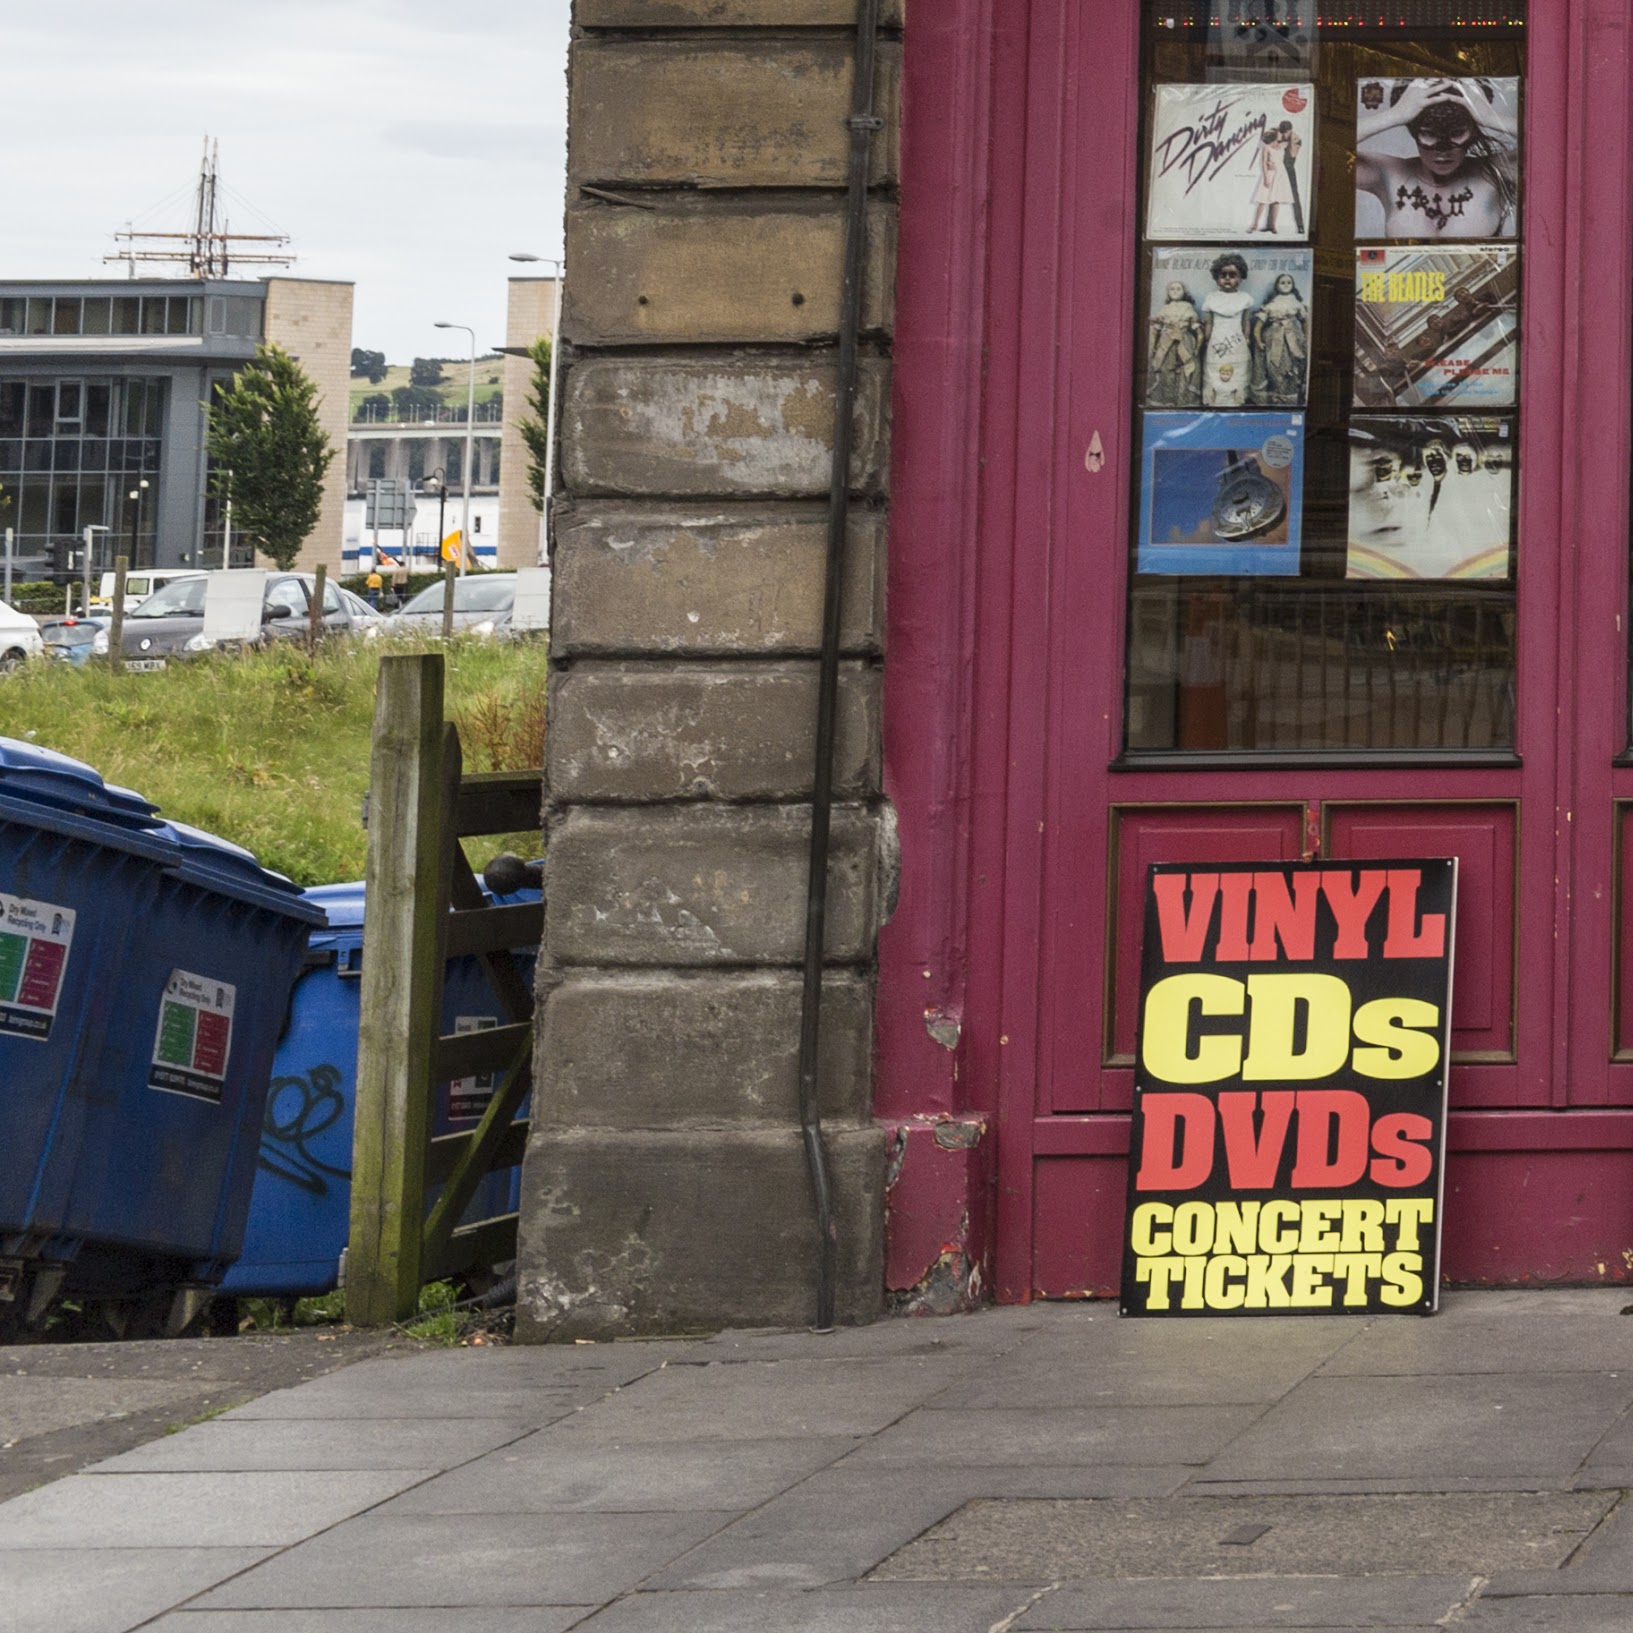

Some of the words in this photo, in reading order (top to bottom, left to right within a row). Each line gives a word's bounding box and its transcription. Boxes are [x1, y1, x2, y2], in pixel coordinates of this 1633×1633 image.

[1156, 99, 1242, 178] Dirty
[1178, 111, 1267, 197] Dancing
[1361, 272, 1386, 302] THE
[1388, 271, 1446, 302] BEATLES
[1153, 869, 1446, 963] VINYL
[1142, 972, 1441, 1084] CDs
[1136, 1089, 1434, 1191] DVDs
[1131, 1198, 1434, 1257] CONCERT
[1136, 1251, 1424, 1310] TICKETS
